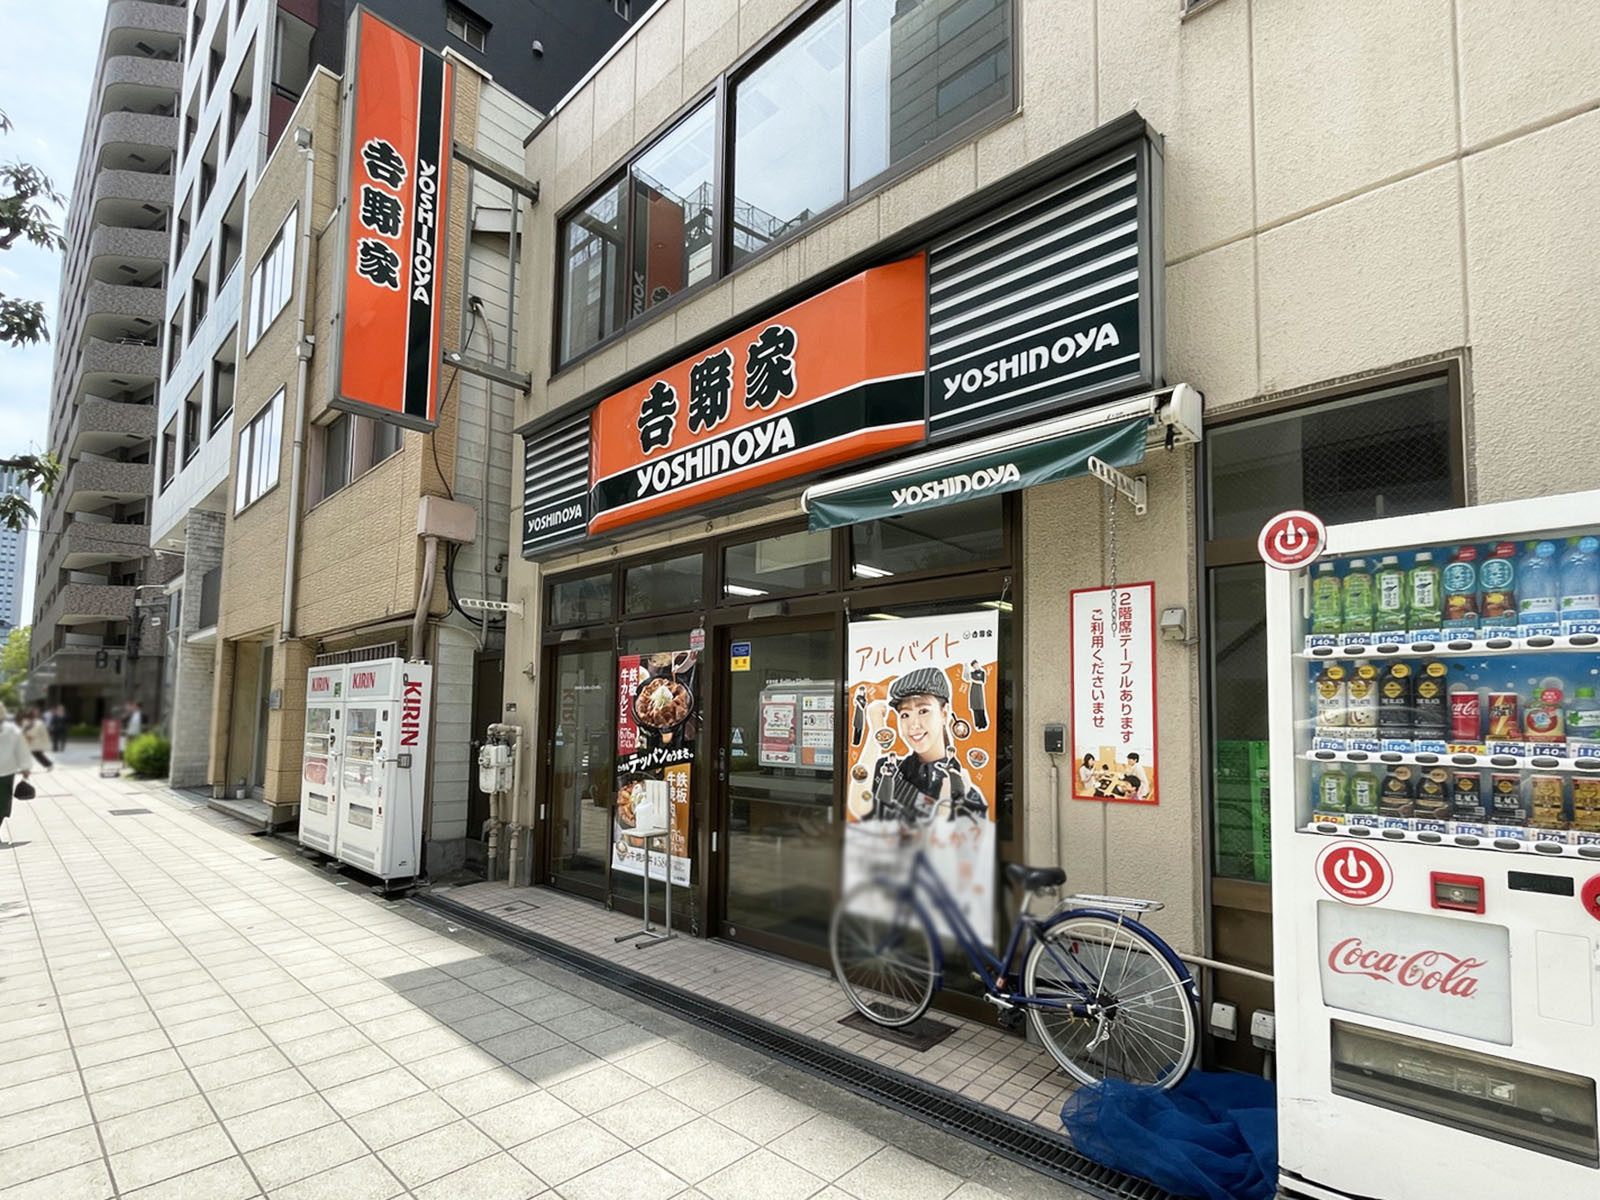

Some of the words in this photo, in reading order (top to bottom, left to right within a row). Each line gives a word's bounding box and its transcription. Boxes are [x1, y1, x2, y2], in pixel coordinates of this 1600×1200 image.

[356, 136, 408, 292] 吉野家
[413, 159, 436, 306] YOSHINOYA
[637, 324, 799, 455] 吉野家
[943, 322, 1120, 400] YOSHINOYA
[636, 417, 796, 498] YOSHINOYA
[891, 463, 1021, 508] YOSHINOYA
[527, 504, 583, 533] YOSHINOYA
[311, 677, 330, 691] KIRIN
[352, 671, 376, 689] KIRIN
[855, 632, 960, 672] アルバイト
[1090, 608, 1105, 728] ご利用くださいませ
[1118, 592, 1134, 744] 2階席テーブルあります
[400, 681, 423, 746] KIRIN
[1328, 937, 1488, 998] Coca-Cola
